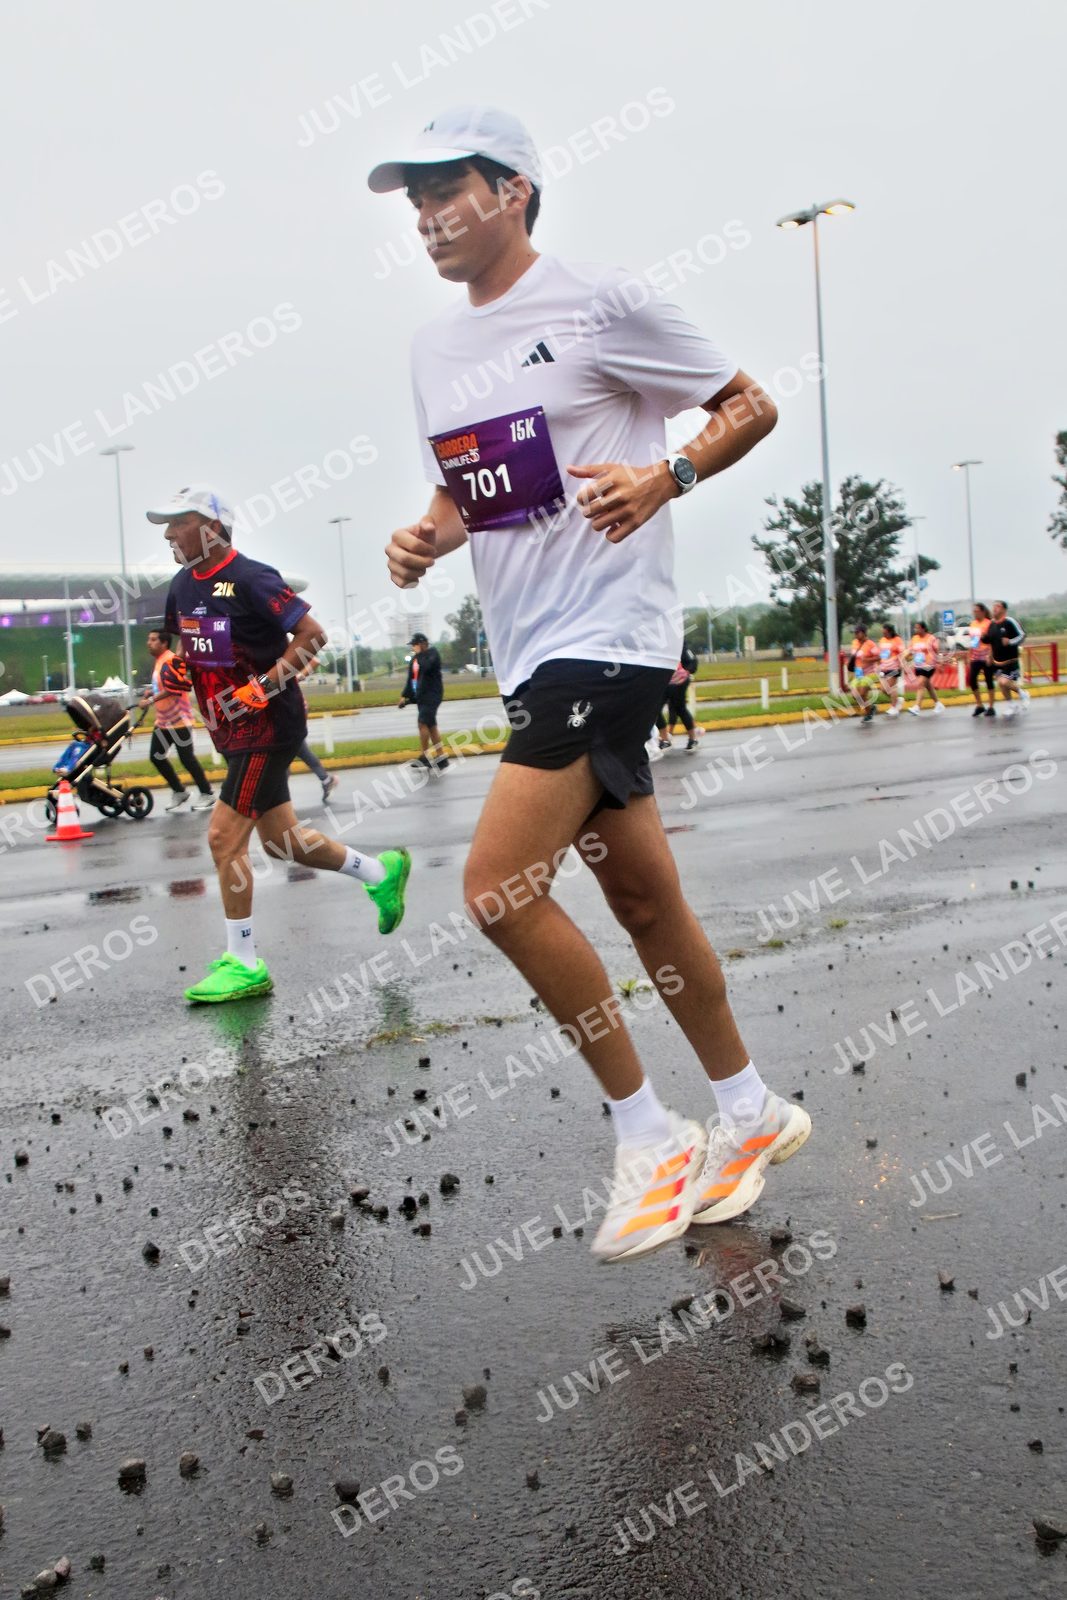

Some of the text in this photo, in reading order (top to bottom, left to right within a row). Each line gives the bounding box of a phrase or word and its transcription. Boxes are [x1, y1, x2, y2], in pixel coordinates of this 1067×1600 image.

[510, 417, 536, 442] 15K
[462, 464, 512, 500] 701
[211, 582, 236, 597] 21K
[213, 620, 226, 631] 15K
[191, 637, 213, 652] 761
